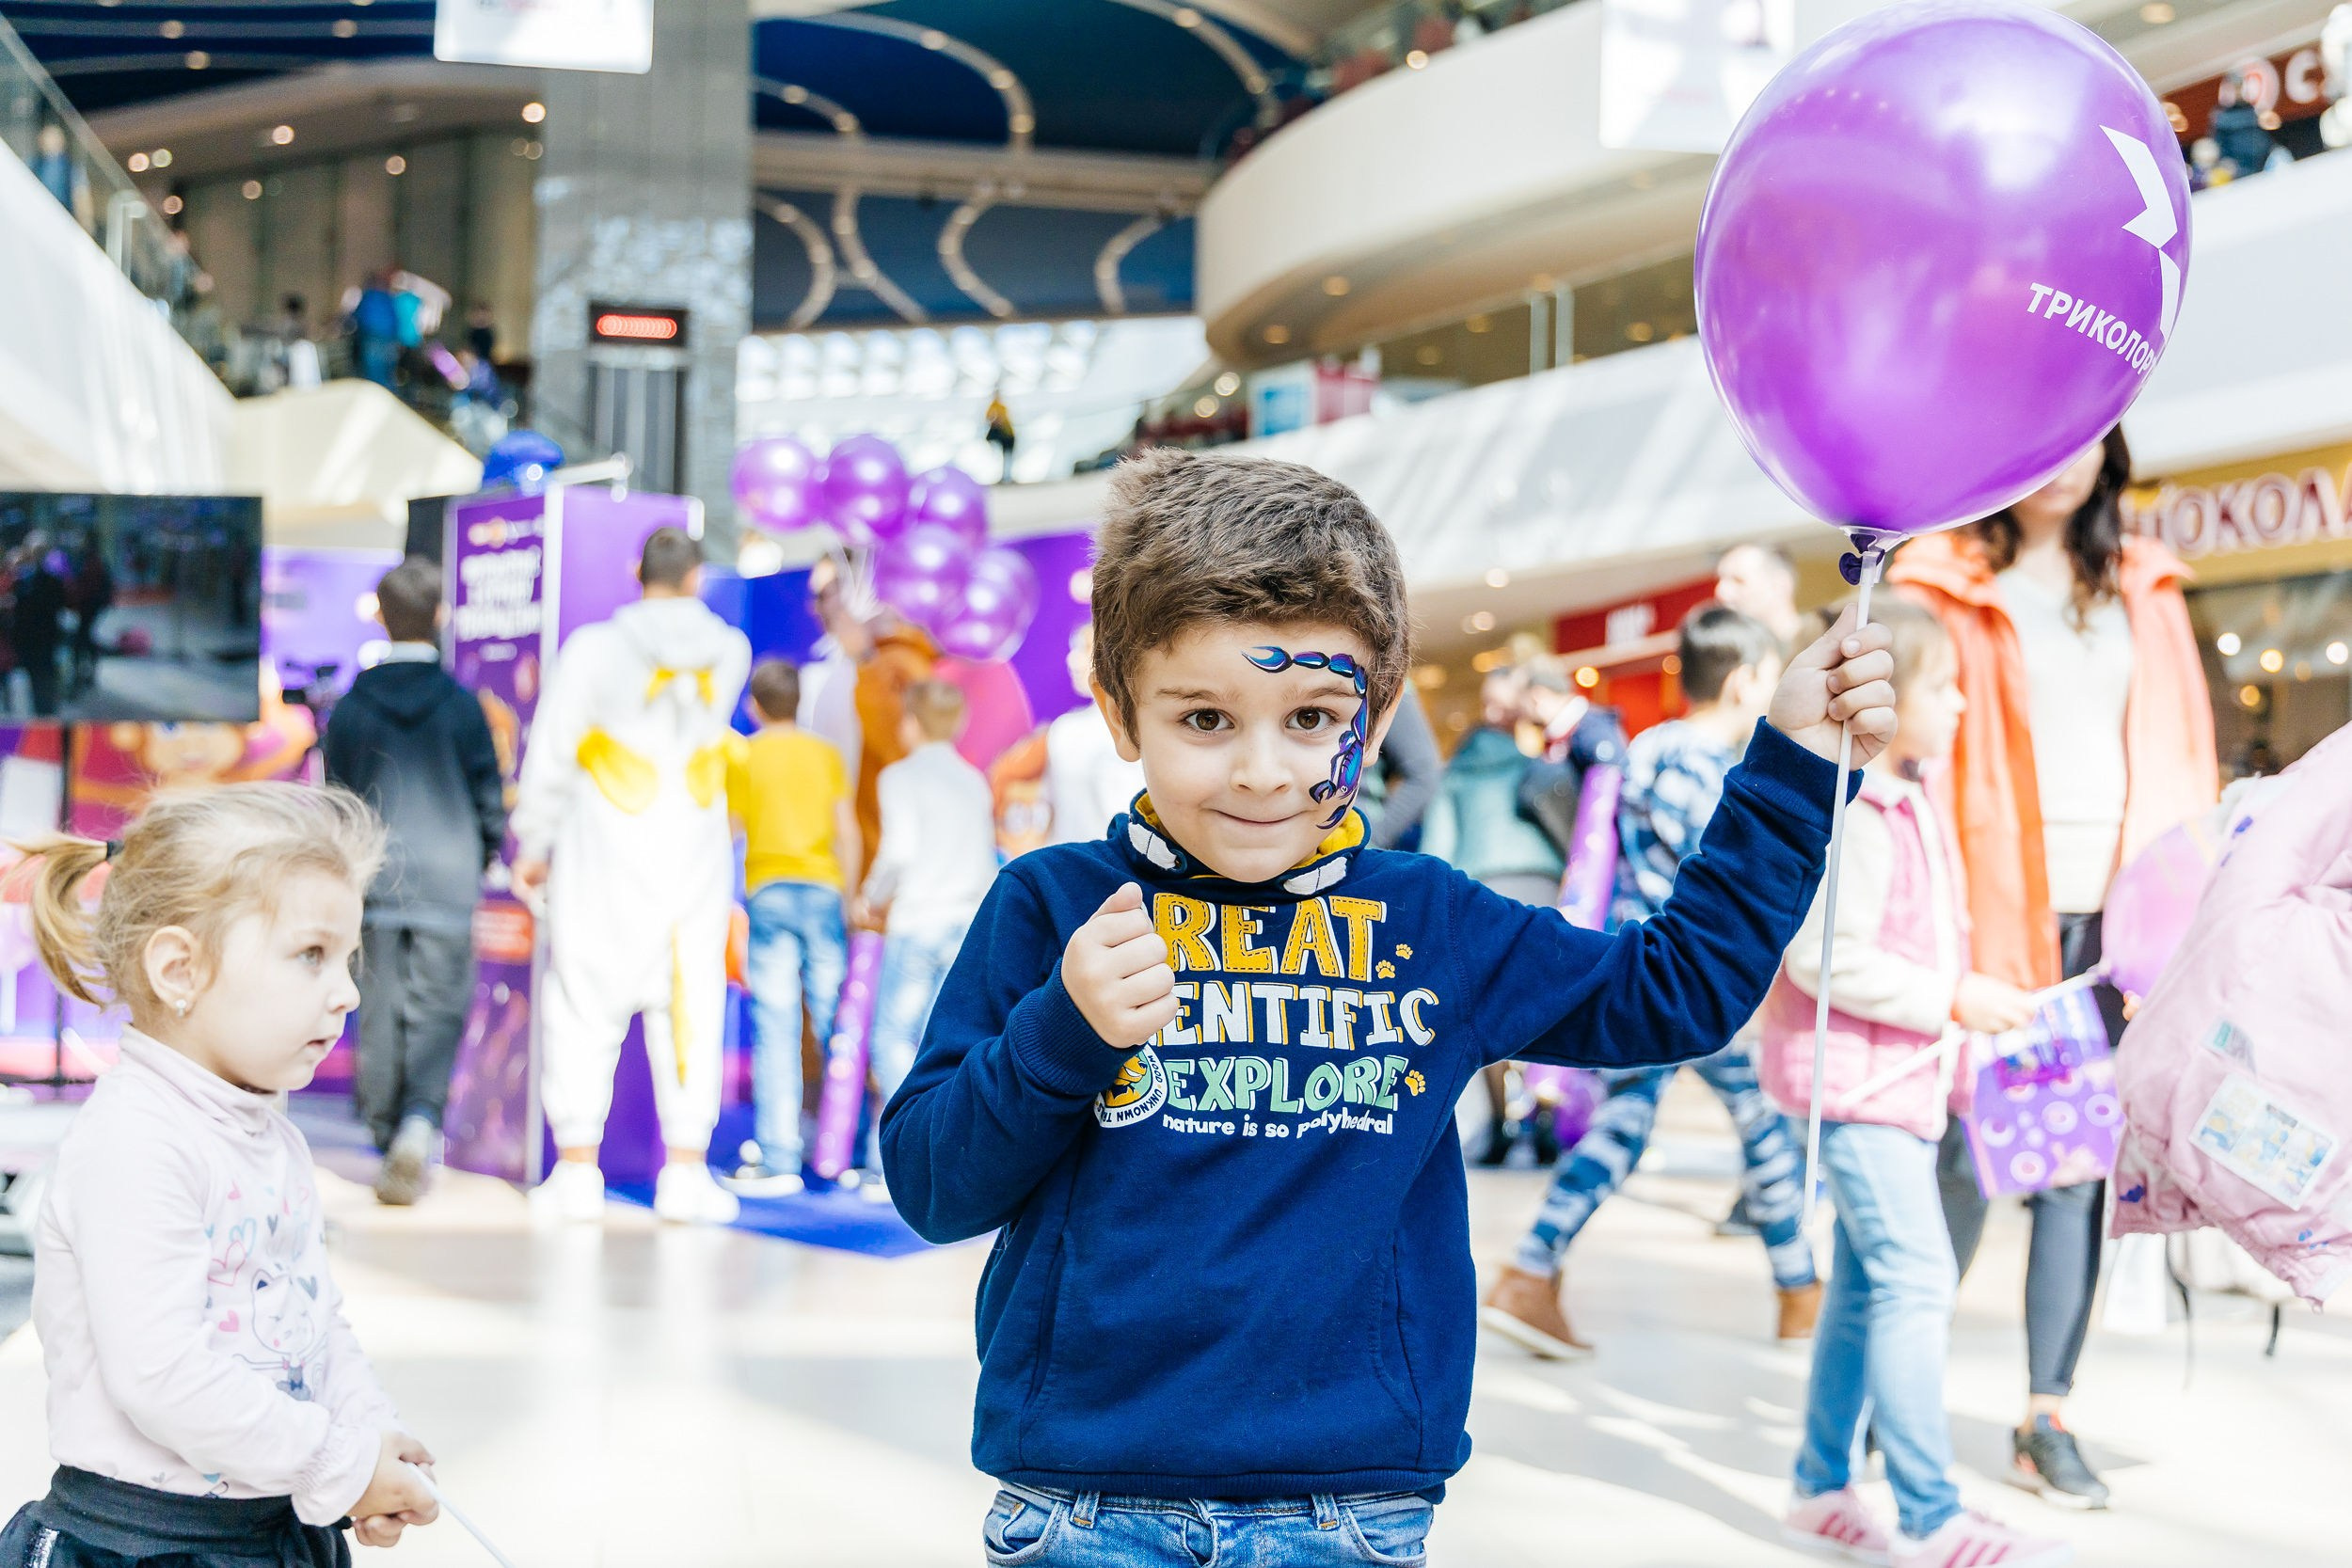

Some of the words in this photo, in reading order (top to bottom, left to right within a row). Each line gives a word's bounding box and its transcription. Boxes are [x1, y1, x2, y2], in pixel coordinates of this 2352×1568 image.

[2026, 282, 2154, 375] ТРИКОЛОР
[1141, 892, 1387, 982] REAT
[1116, 1088, 1163, 1122] UNKNOWN
[1163, 1054, 1408, 1113] EXPLORE
[1162, 1114, 1236, 1135] nature
[1242, 1114, 1259, 1137] is
[1264, 1122, 1290, 1138] so
[1295, 1106, 1393, 1139] polyhedral
